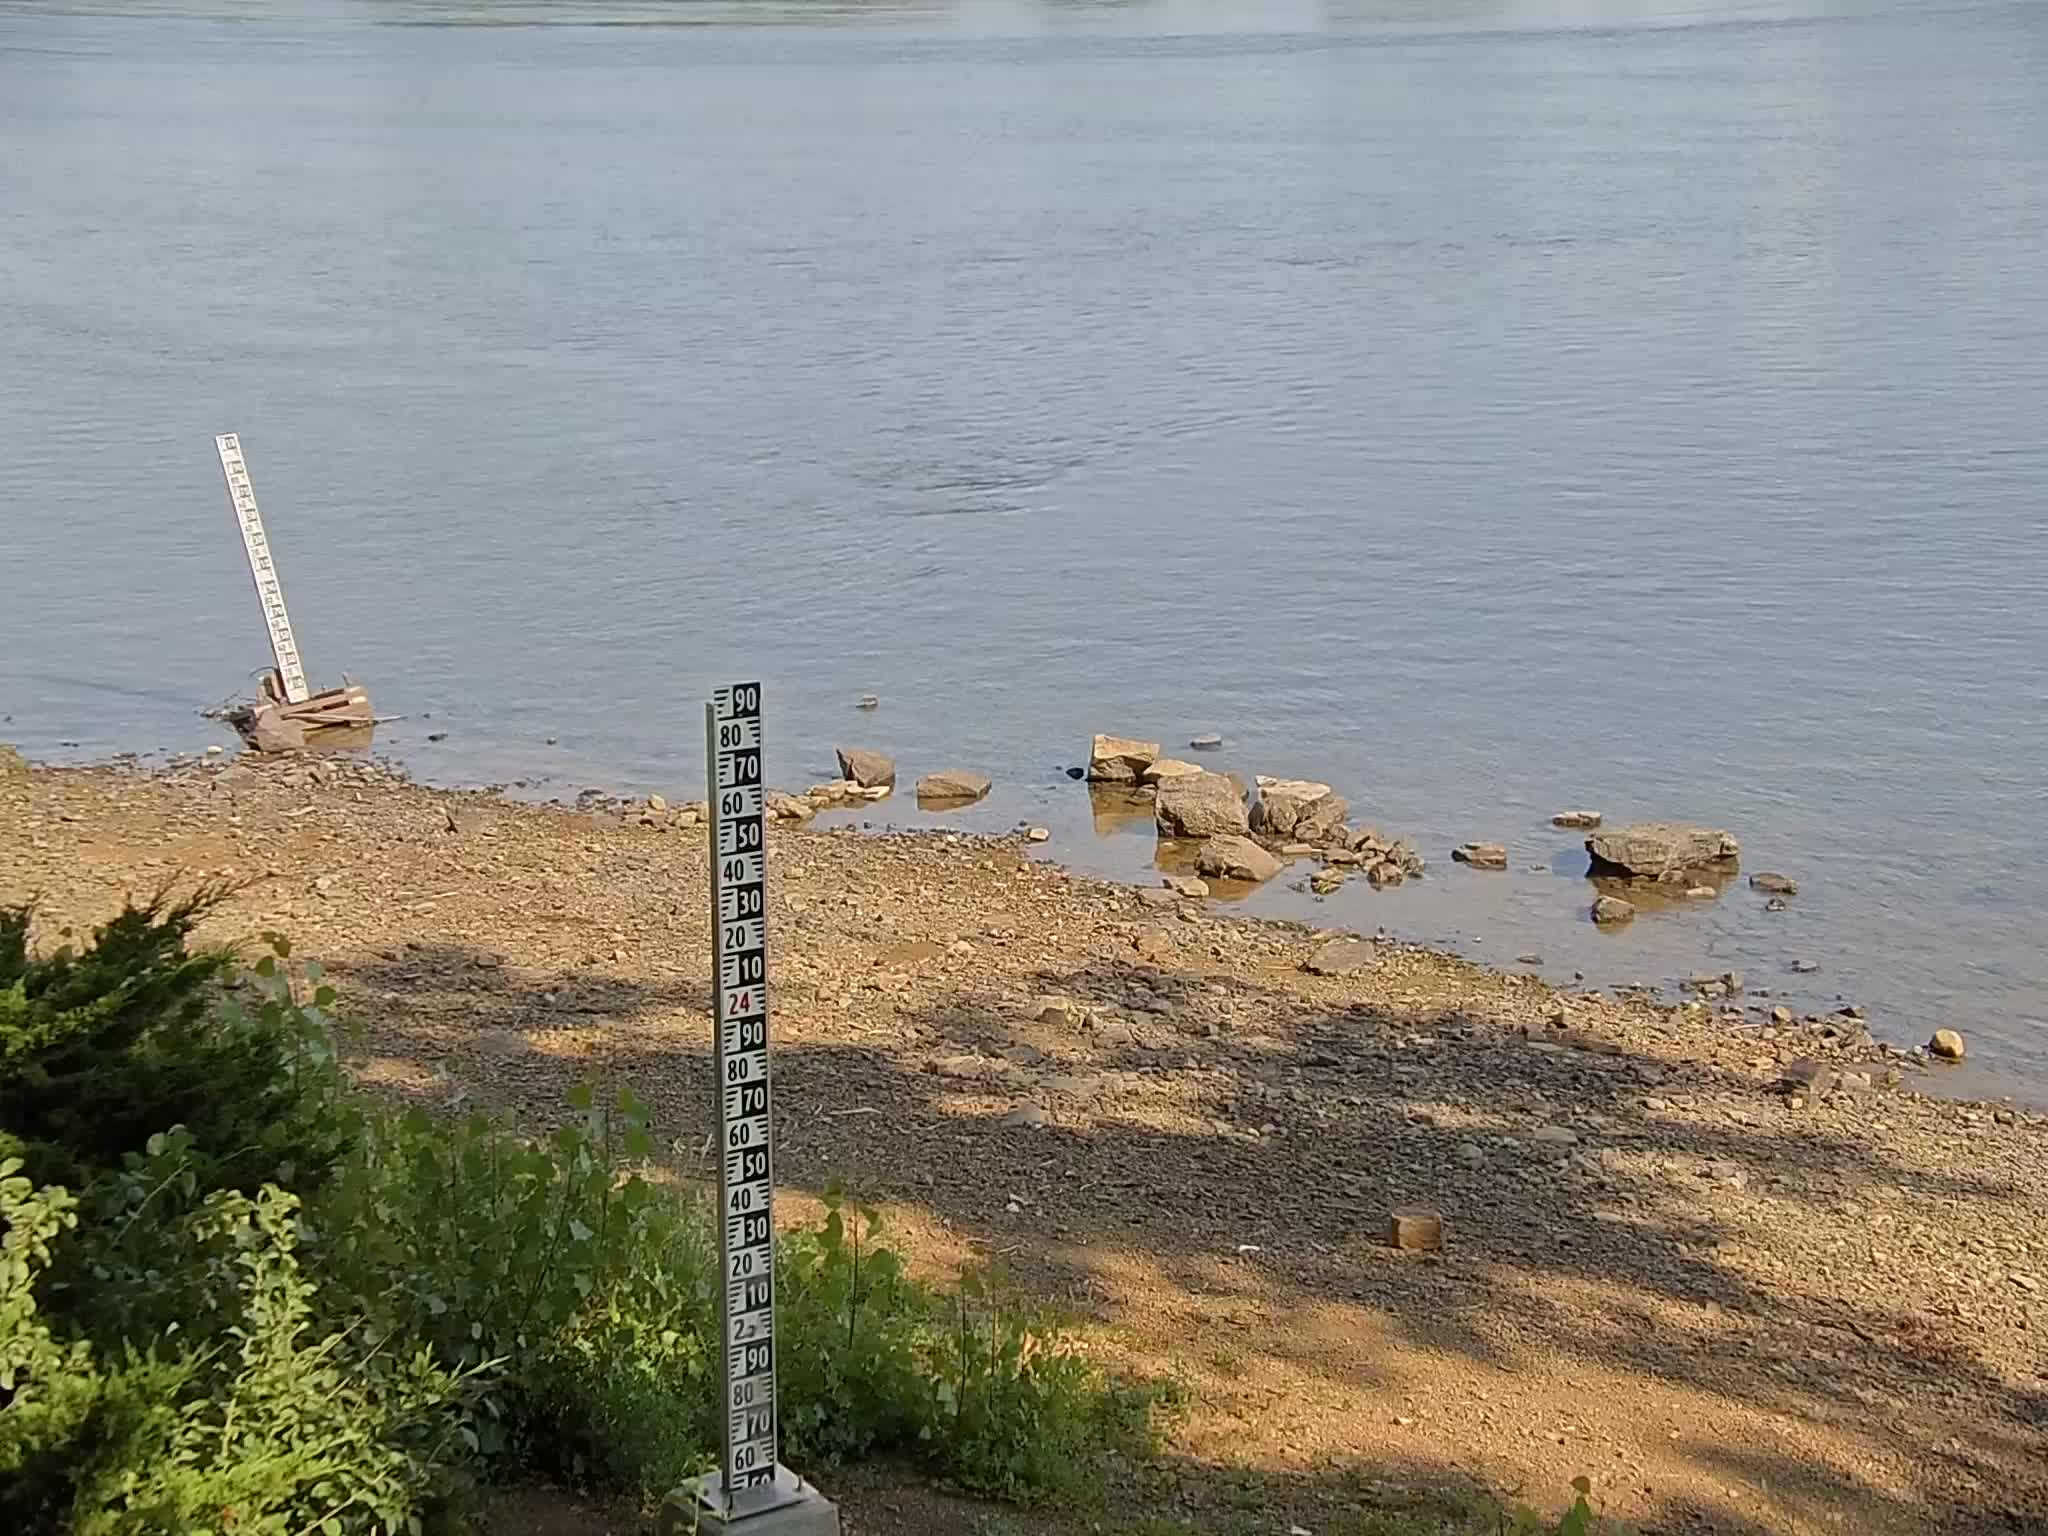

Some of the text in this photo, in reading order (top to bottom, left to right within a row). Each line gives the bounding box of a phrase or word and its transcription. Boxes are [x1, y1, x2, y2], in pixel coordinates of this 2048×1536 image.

[735, 687, 757, 712] 90
[721, 724, 741, 747] 80
[736, 755, 758, 780] 70
[722, 792, 742, 815] 60
[739, 823, 759, 848] 50
[724, 859, 744, 882] 40
[740, 890, 760, 915] 30
[725, 926, 745, 949] 20
[742, 956, 761, 980] 10
[729, 992, 750, 1015] 24
[742, 1023, 763, 1047] 90
[728, 1057, 748, 1081] 80
[744, 1087, 765, 1111] 70
[729, 1123, 750, 1146] 60
[746, 1152, 766, 1176] 50
[731, 1188, 751, 1210] 40
[746, 1216, 767, 1241] 30
[732, 1253, 752, 1277] 20
[749, 1283, 768, 1307] 10
[748, 1345, 769, 1370] 90
[733, 1382, 753, 1406] 80
[749, 1414, 770, 1437] 70
[735, 1446, 755, 1470] 60
